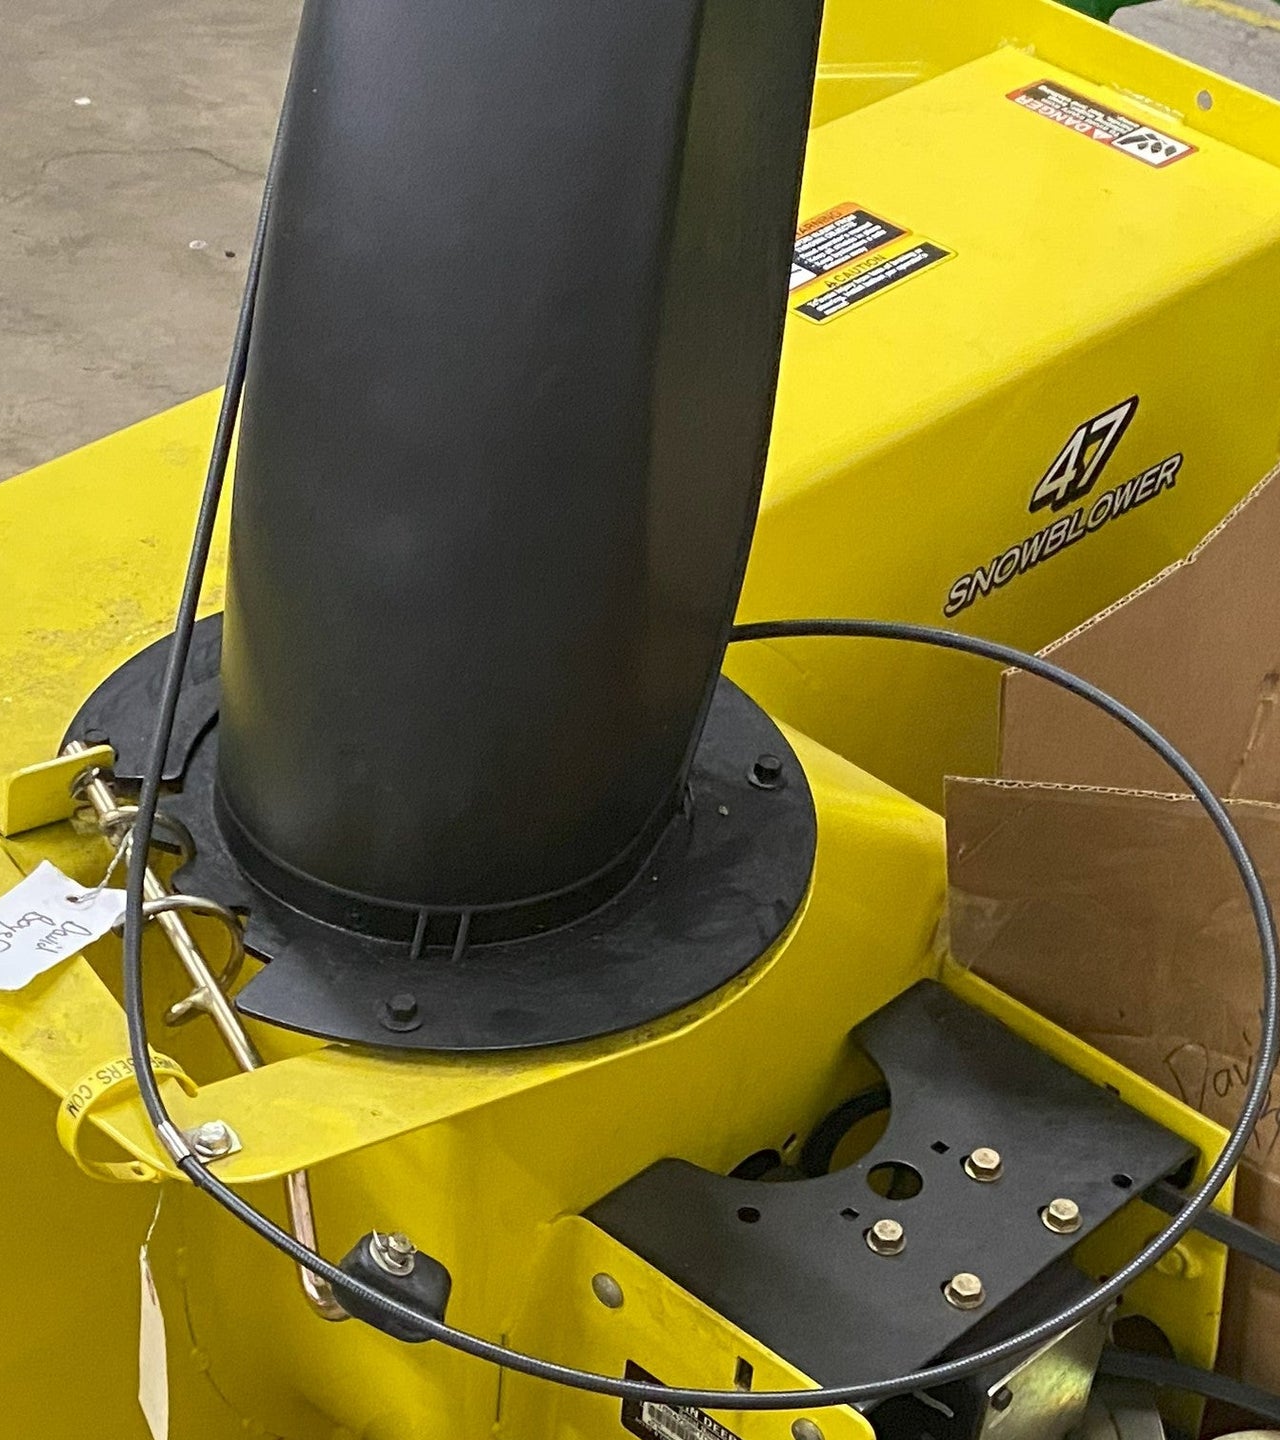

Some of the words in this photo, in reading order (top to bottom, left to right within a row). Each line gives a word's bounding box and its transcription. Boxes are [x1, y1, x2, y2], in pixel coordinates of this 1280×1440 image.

[1015, 95, 1092, 133] DANGER
[834, 253, 886, 282] CAUTION
[1030, 396, 1138, 511] 47
[944, 453, 1183, 617] SNOWBLOWER
[36, 920, 92, 954] David
